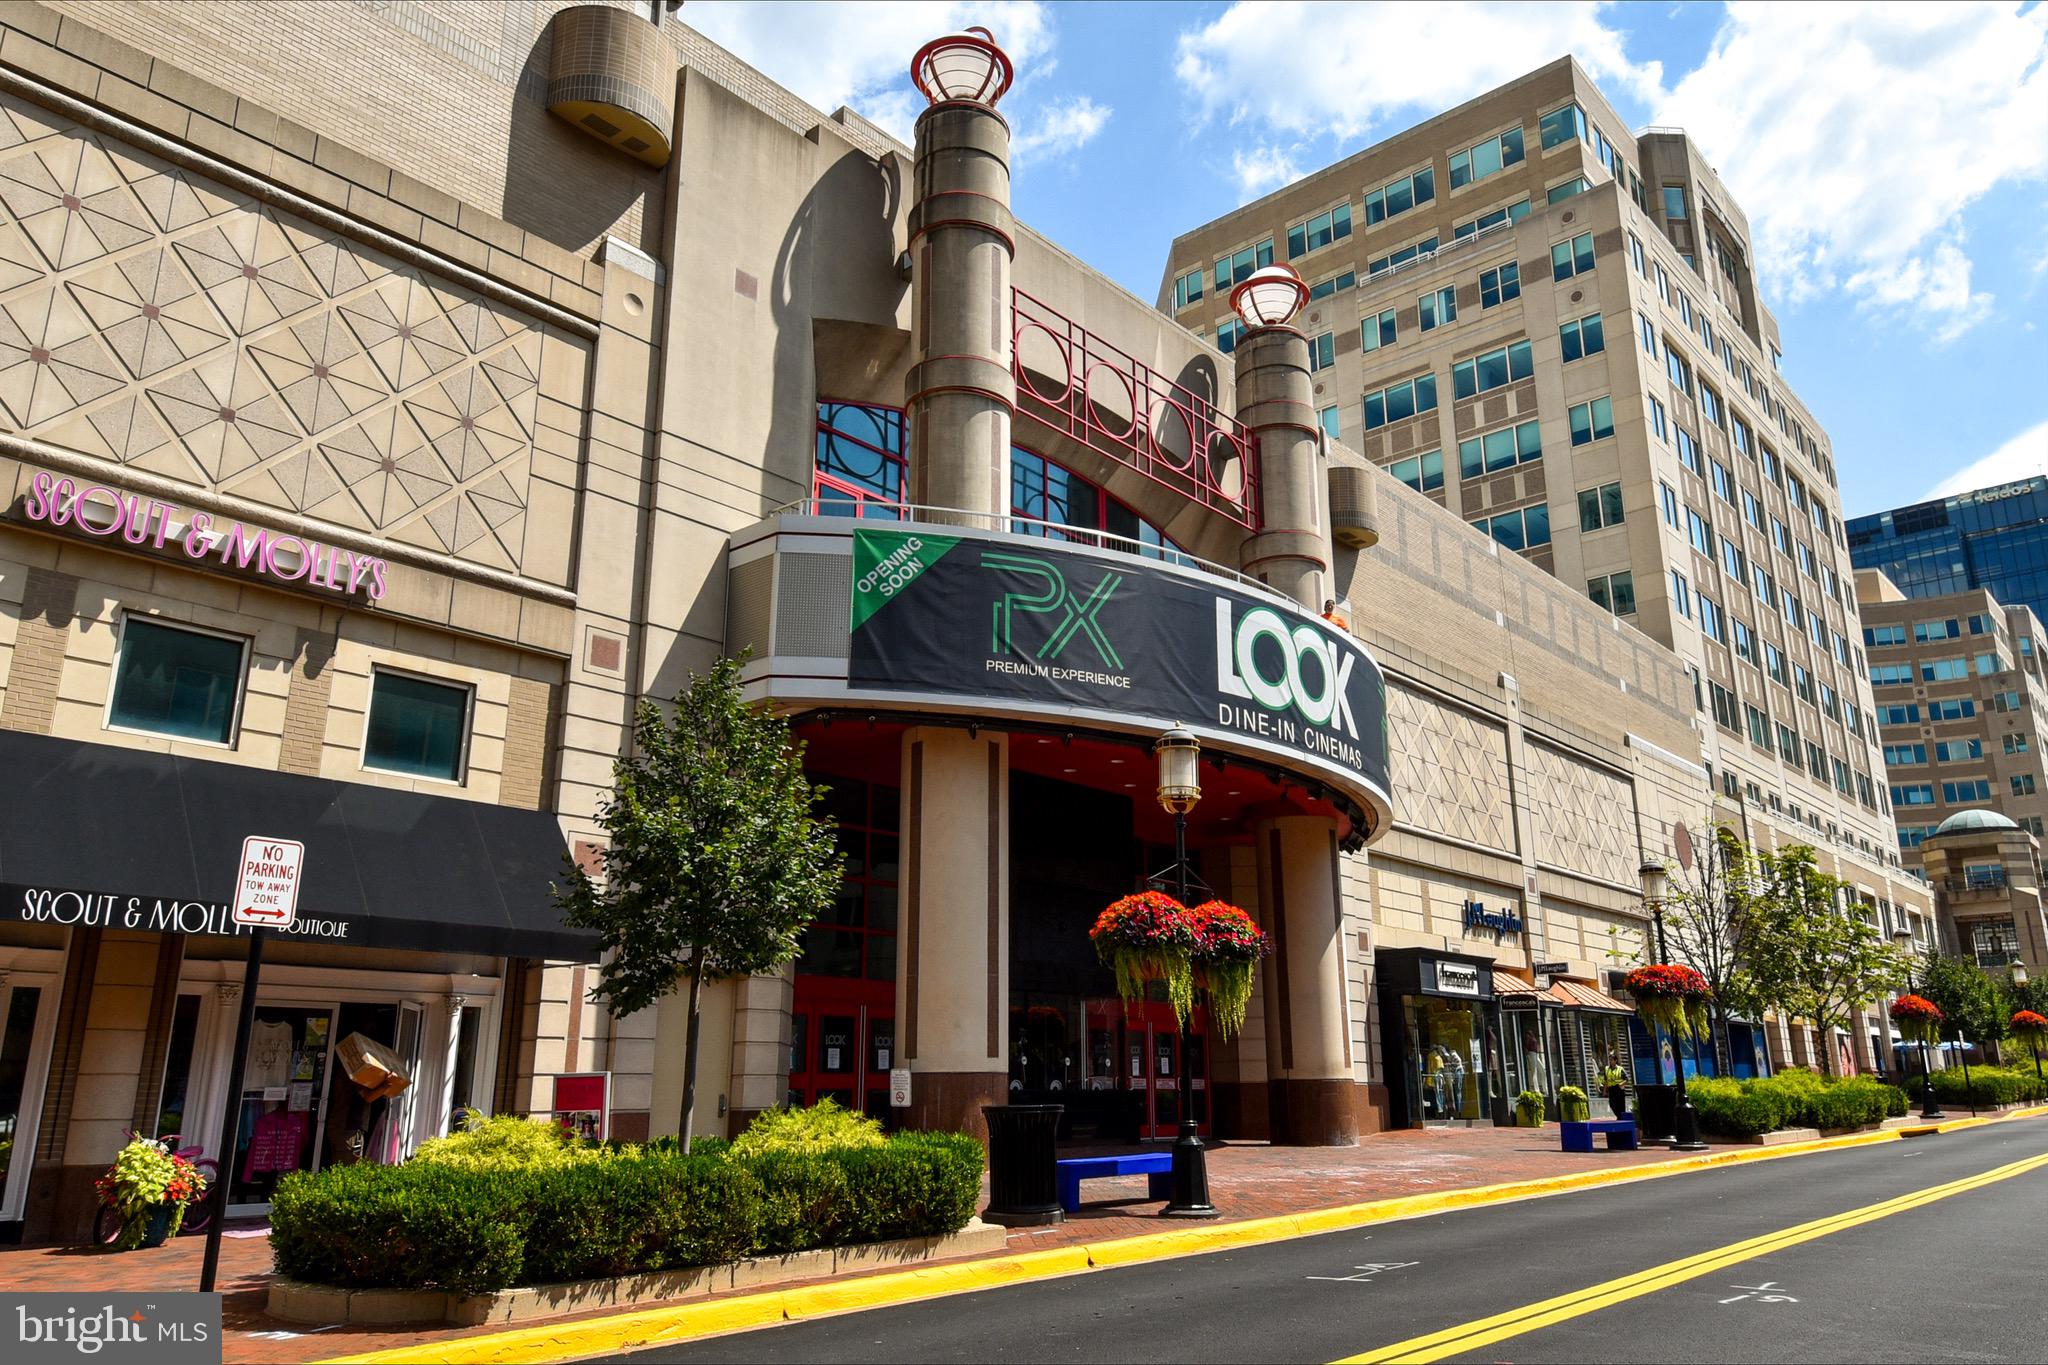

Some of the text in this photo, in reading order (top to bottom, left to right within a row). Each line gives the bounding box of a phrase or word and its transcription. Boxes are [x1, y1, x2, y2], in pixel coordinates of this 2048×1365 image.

[1978, 484, 2032, 503] leidos
[25, 471, 388, 600] SCOUT & MOLLY'S
[857, 536, 924, 594] OPENING
[879, 557, 925, 598] SOON
[981, 552, 1125, 671] PX
[986, 659, 1132, 689] PREMIUM EXPERIENCE
[1215, 596, 1361, 742] LOOK
[1218, 702, 1363, 771] DINE-IN CINEMAS
[262, 845, 284, 862] NO
[246, 861, 295, 880] PARKING
[246, 880, 292, 893] TOW AWAY
[253, 893, 280, 905] ZONE
[22, 888, 349, 938] SCOUT & MOLL OUTIQUE
[825, 1034, 847, 1046] LOOK
[874, 1036, 894, 1047] LOOK
